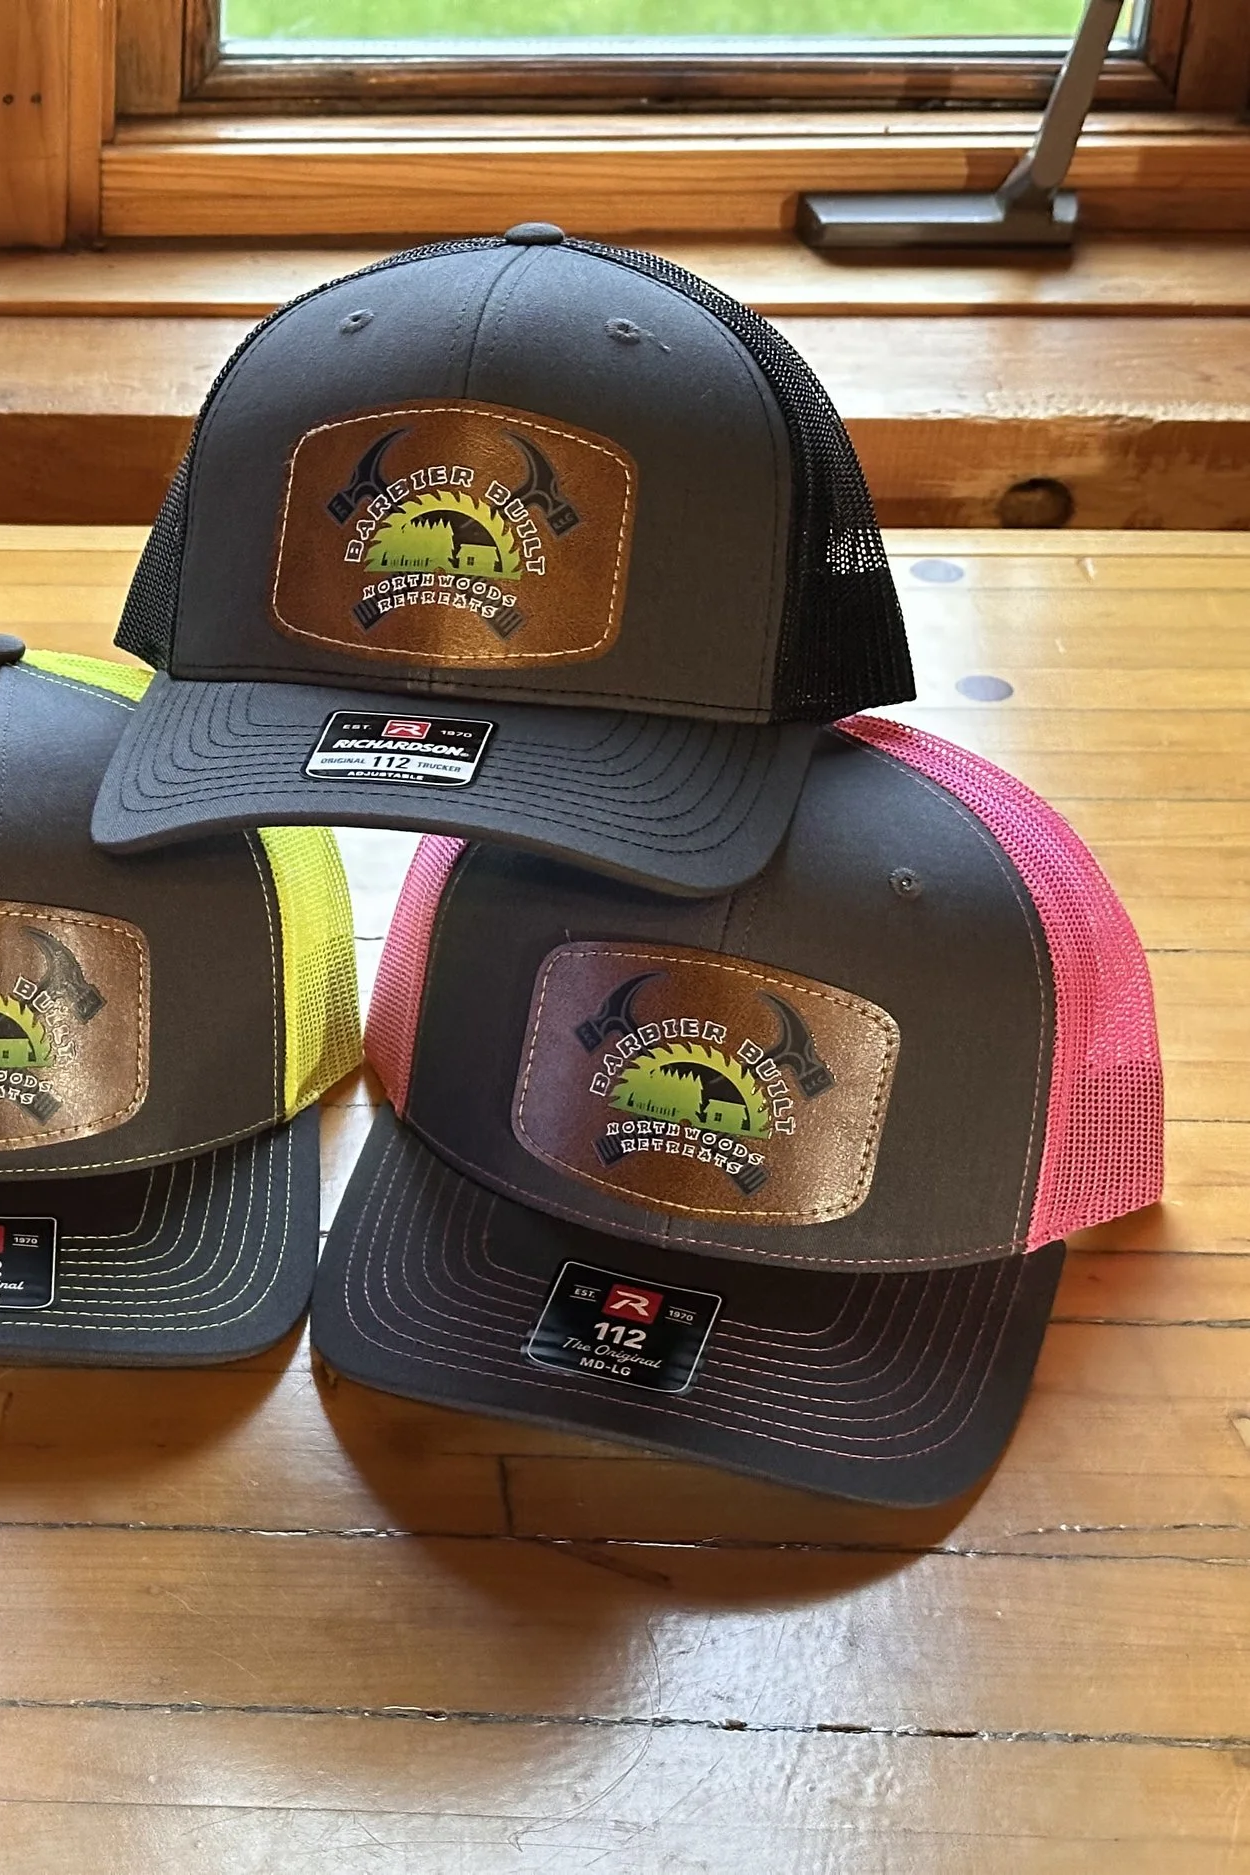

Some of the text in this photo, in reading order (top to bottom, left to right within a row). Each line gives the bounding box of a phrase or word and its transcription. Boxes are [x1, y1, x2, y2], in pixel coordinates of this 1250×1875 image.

[344, 465, 546, 577] BARBIER BUILT
[378, 590, 498, 620] RETREATS
[440, 729, 473, 738] 1970
[320, 755, 461, 773] ORIGINAL 112 TRUCKER
[347, 770, 424, 781] ADJUSTABLE
[589, 1018, 794, 1136] BARBIER BUILT
[621, 1138, 745, 1175] RETREATS
[13, 1236, 38, 1245] 1970
[574, 1287, 596, 1299] EST.
[668, 1309, 694, 1323] 1970
[594, 1322, 647, 1350] 112
[562, 1336, 663, 1369] The Original
[579, 1356, 632, 1377] MD-LG
